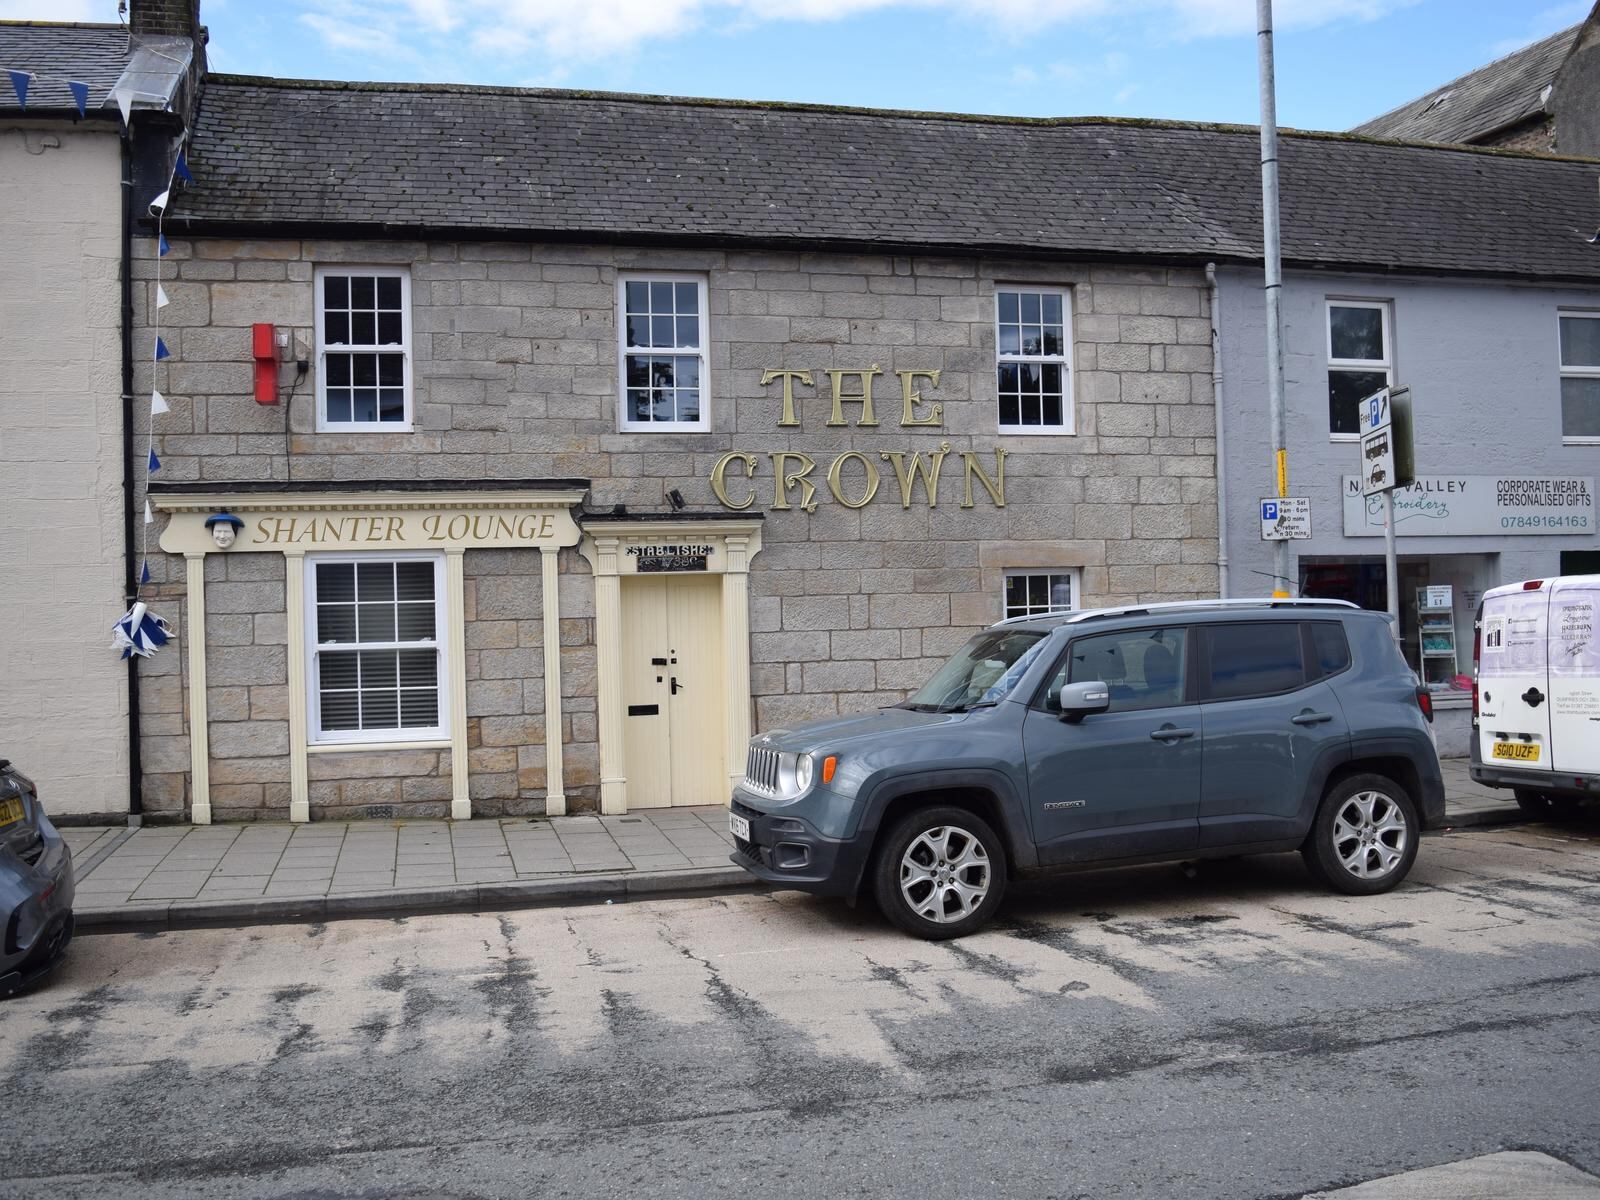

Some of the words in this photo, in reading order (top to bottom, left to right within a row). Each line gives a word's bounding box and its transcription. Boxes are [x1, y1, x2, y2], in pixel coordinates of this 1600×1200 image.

[760, 363, 943, 427] THE
[1360, 413, 1370, 425] Free
[709, 441, 1008, 513] CROWN
[1404, 480, 1467, 492] VALLEY
[1496, 480, 1551, 493] CORPORATE
[1552, 480, 1578, 493] WEAR
[1580, 480, 1586, 493] &
[1497, 493, 1564, 506] PERSONALISED
[1566, 493, 1591, 506] GIFTS
[1501, 515, 1588, 528] 07849164163
[252, 515, 407, 544] SHANTER
[422, 513, 555, 541] LOUNGE
[1496, 744, 1514, 757] SG10
[1515, 745, 1534, 758] UZF
